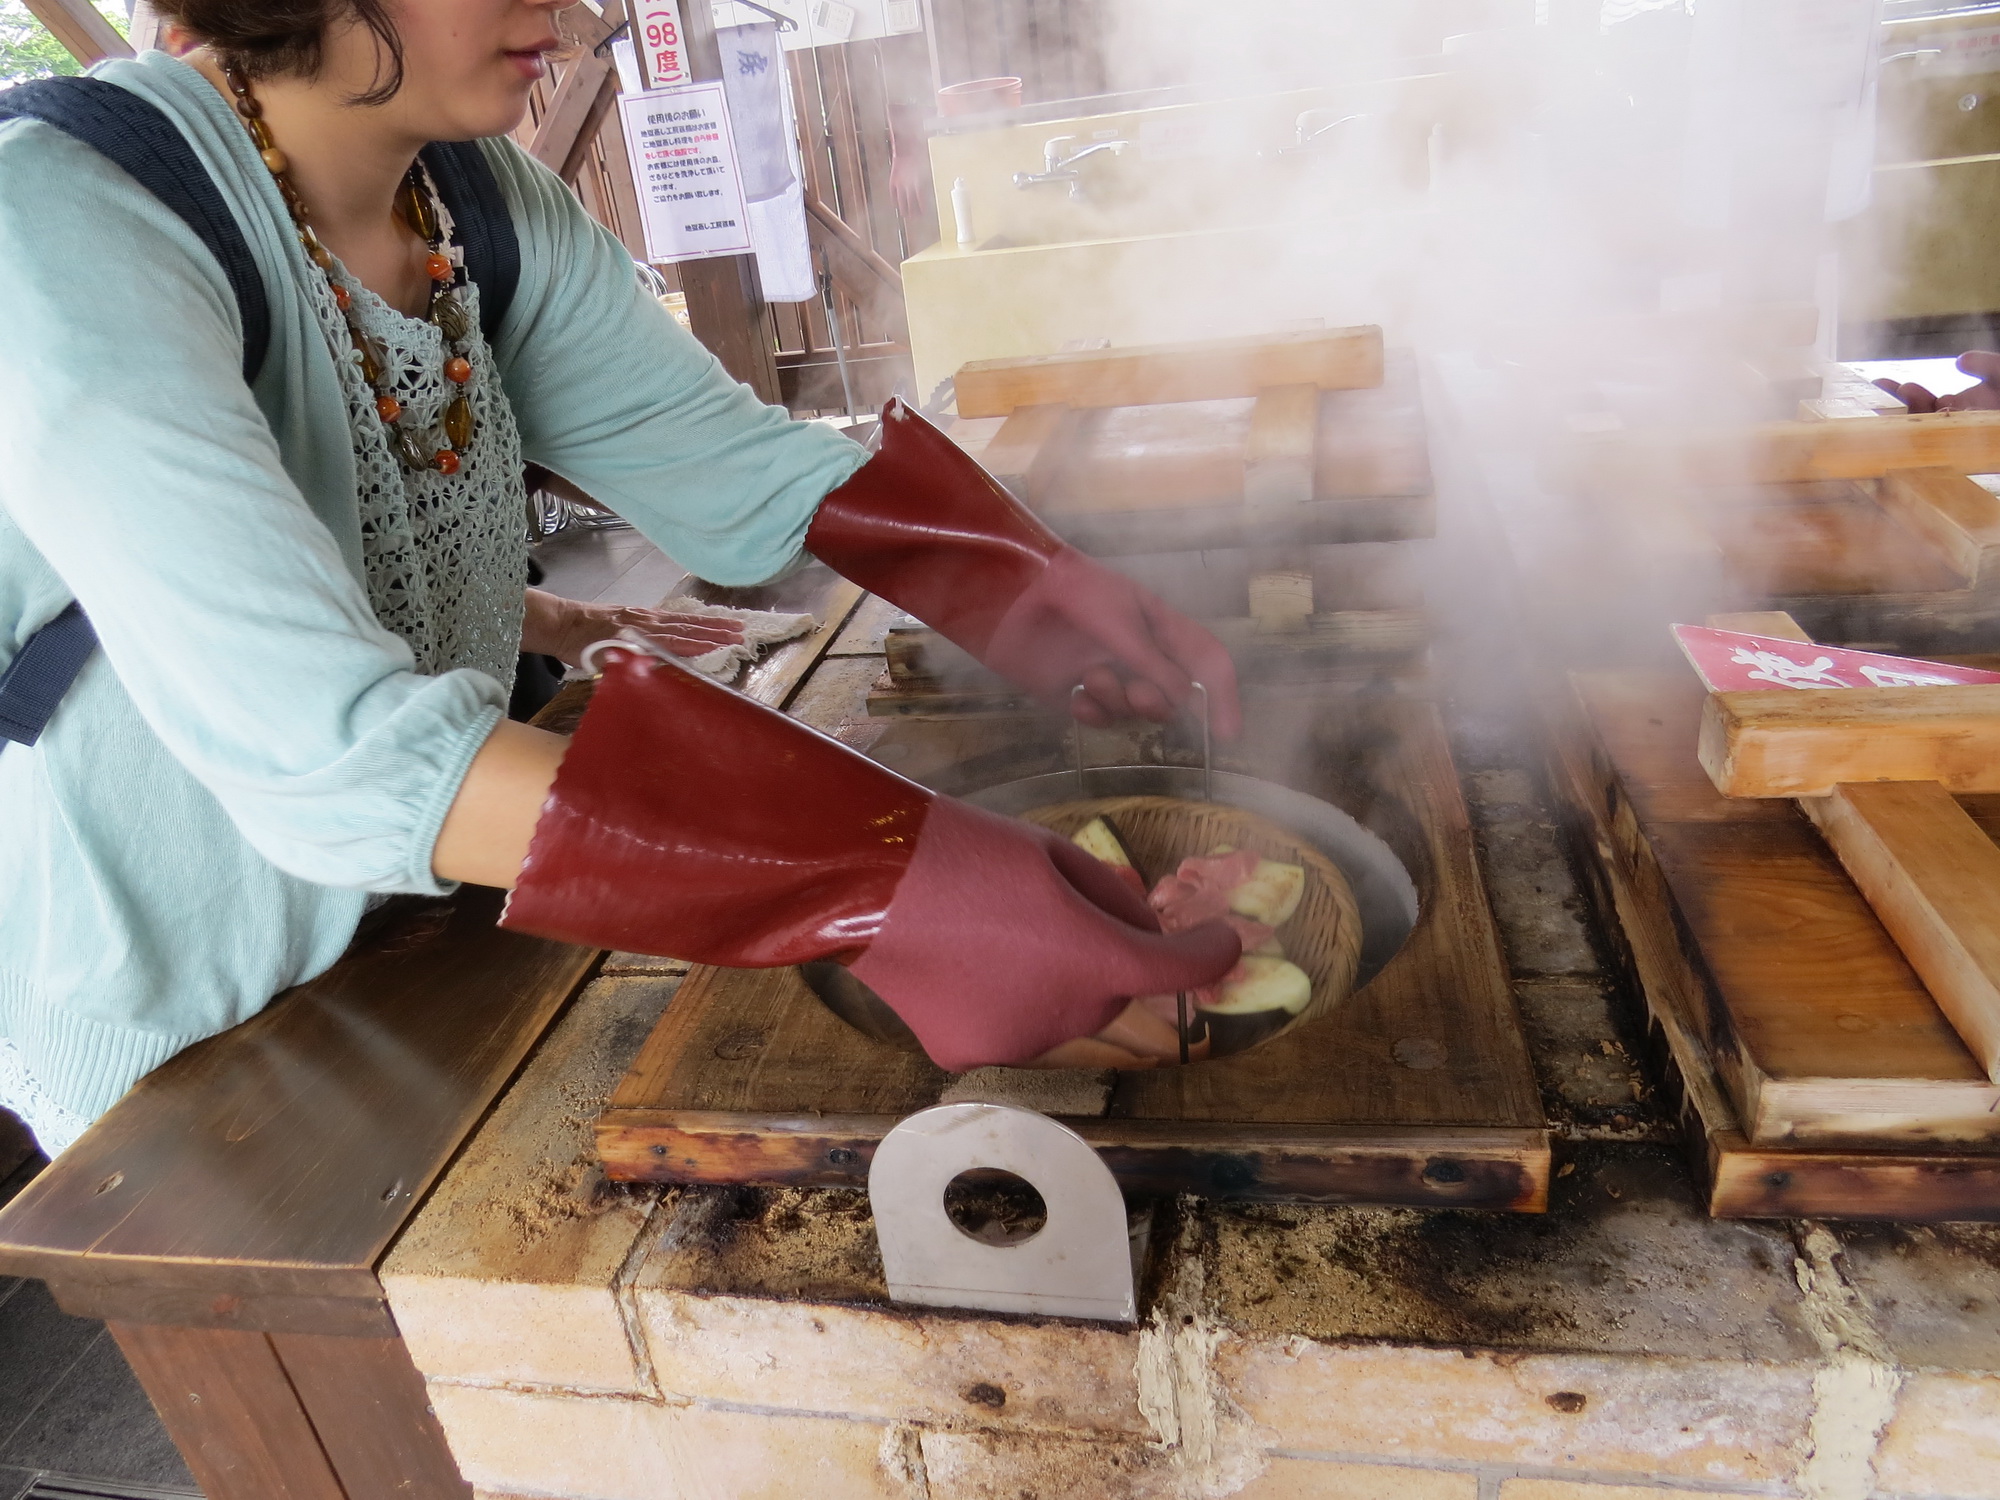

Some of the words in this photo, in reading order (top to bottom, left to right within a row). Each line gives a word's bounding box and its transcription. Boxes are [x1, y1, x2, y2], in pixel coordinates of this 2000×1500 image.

[645, 0, 683, 82] (98度)
[647, 109, 706, 126] 使用後のお願い
